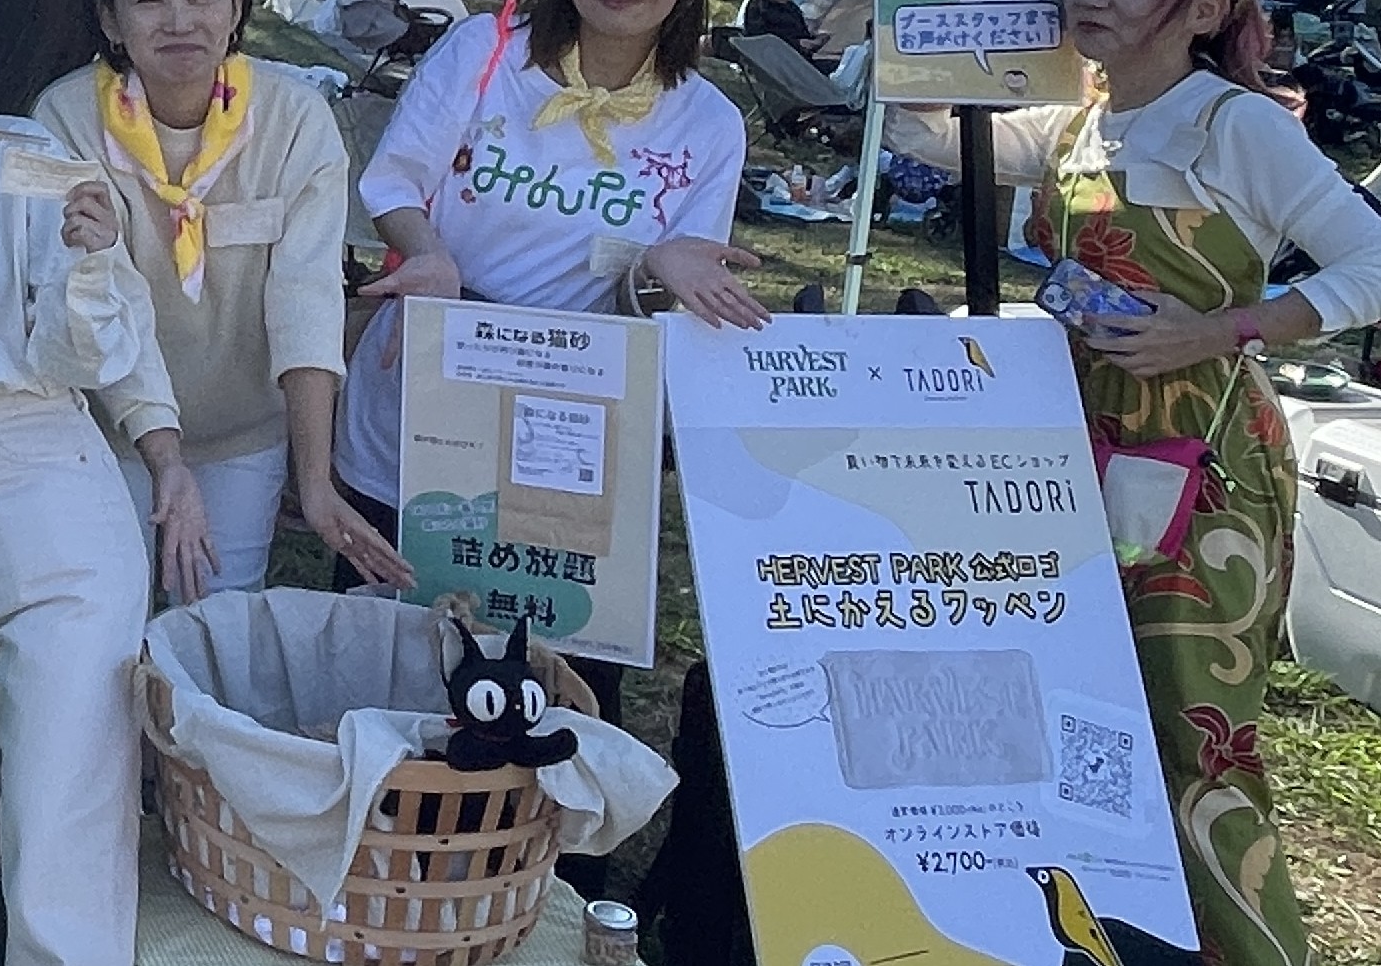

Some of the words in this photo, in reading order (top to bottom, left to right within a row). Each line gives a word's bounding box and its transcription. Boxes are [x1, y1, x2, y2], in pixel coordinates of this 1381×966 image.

[475, 321, 591, 352] 森になる猫砂
[743, 345, 849, 372] HARVEST
[769, 376, 838, 403] PARK
[965, 480, 1077, 514] TADORi
[452, 536, 597, 586] 詰め放題
[756, 554, 880, 588] HERVEST
[890, 552, 967, 586] PARK
[486, 589, 557, 628] 無料
[767, 590, 1066, 630] 土にかえるワッペン
